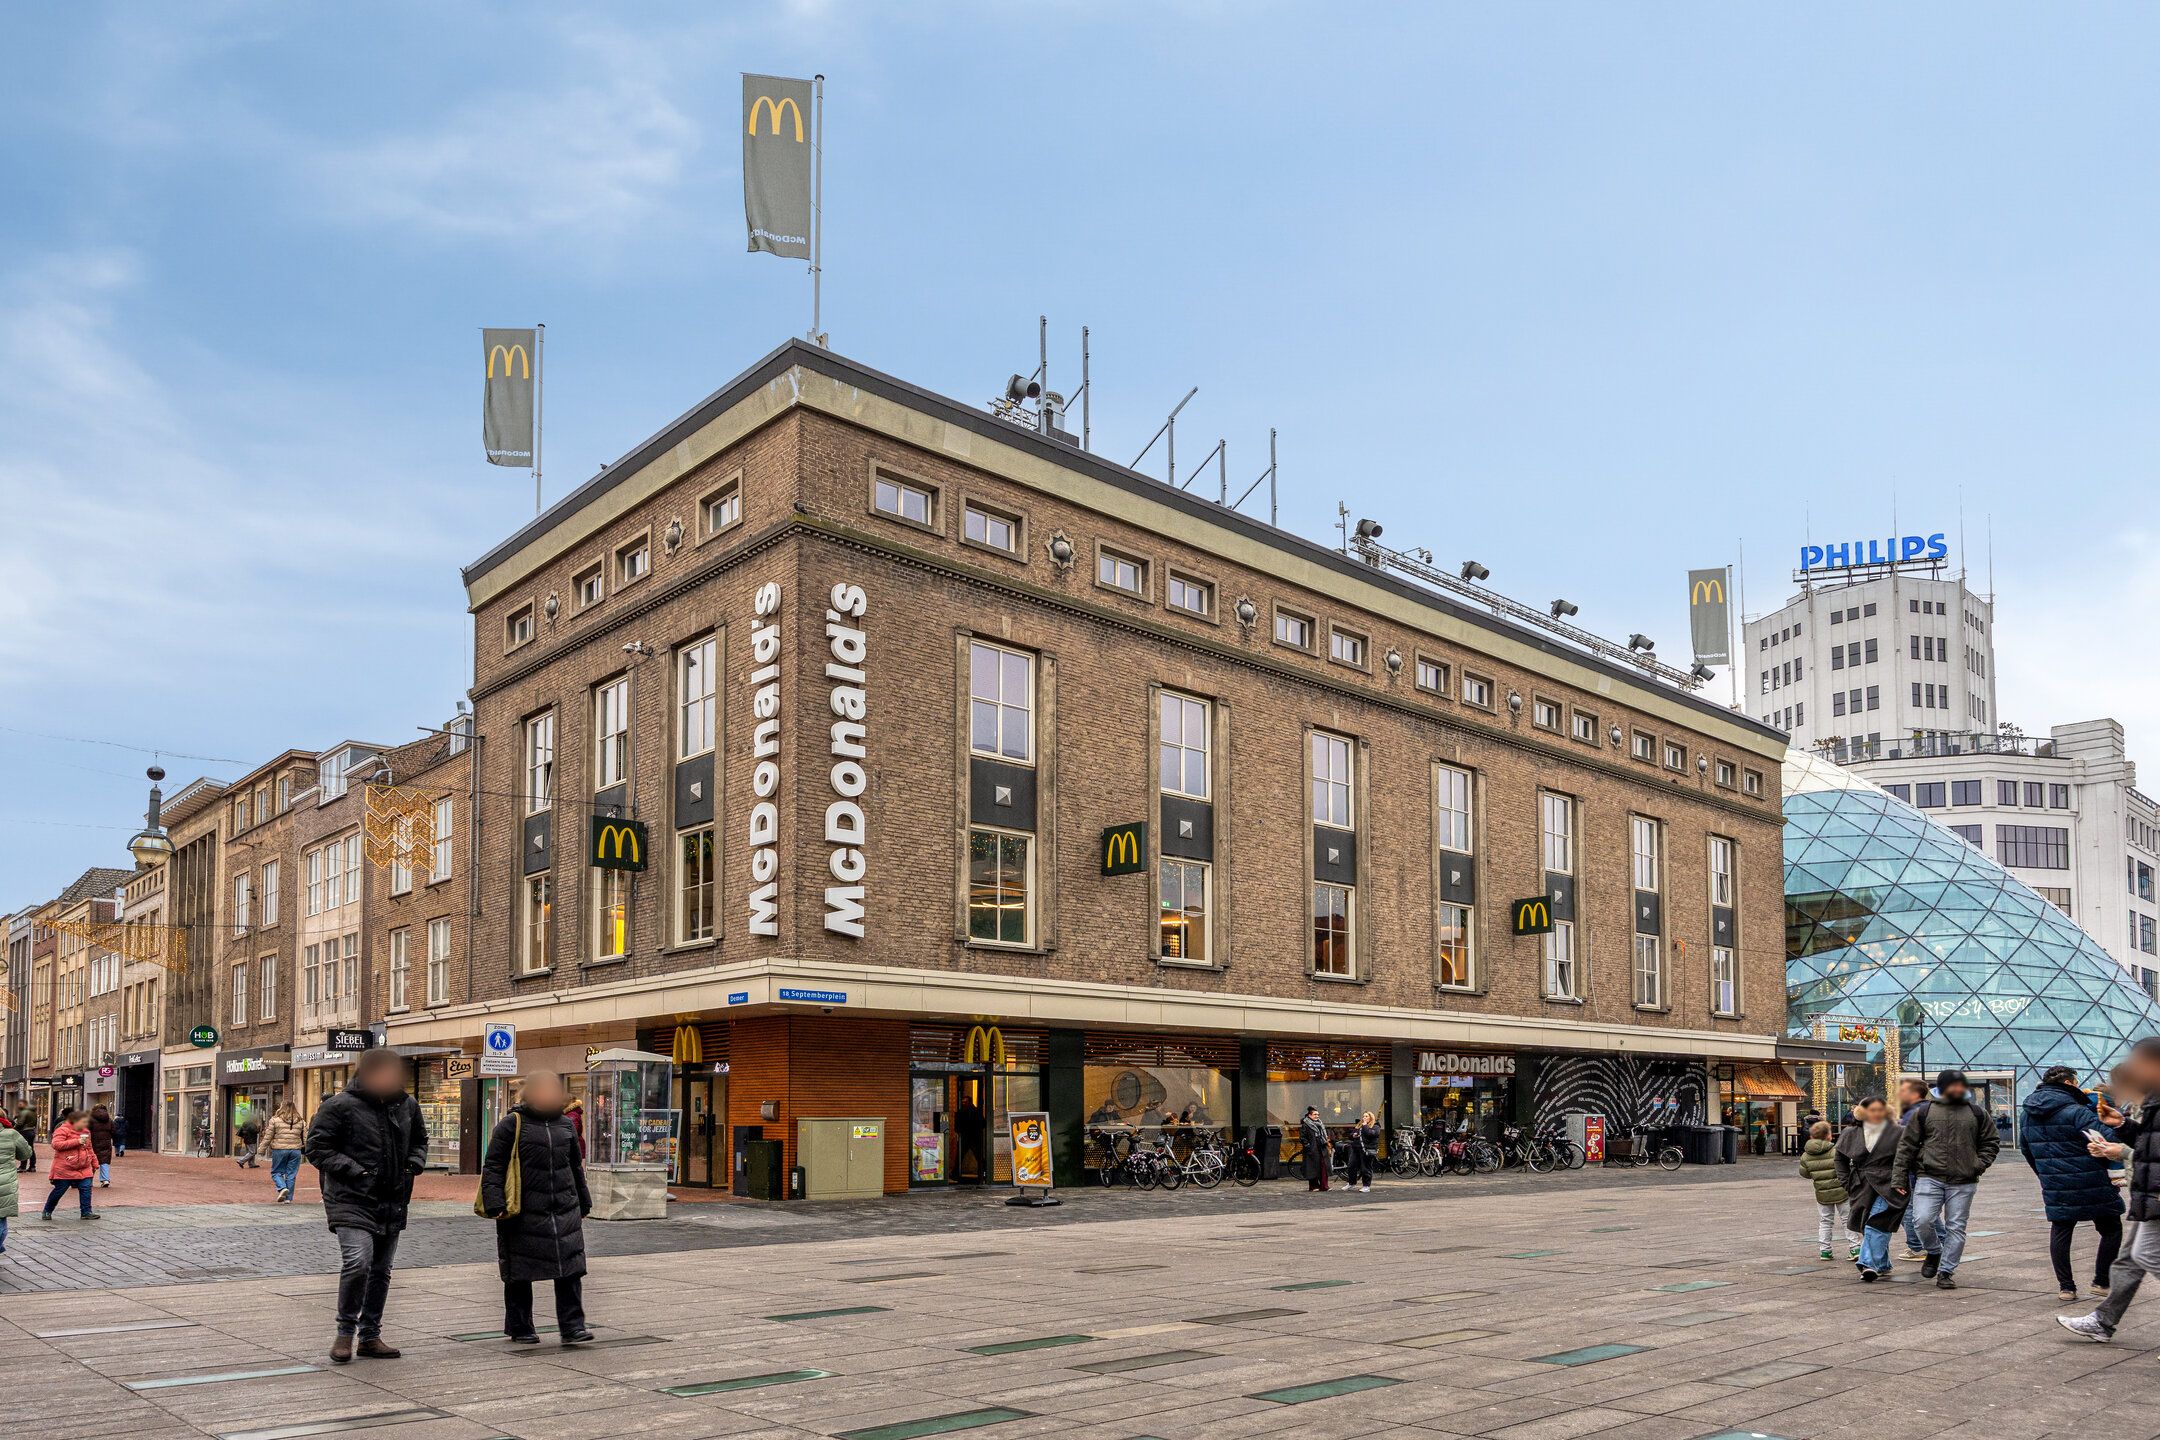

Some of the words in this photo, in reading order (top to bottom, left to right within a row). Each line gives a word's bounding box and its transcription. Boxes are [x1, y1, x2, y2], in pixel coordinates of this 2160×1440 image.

[1800, 533, 1948, 570] PHILIPS
[750, 581, 782, 936] McDonald's
[824, 582, 867, 938] McDonald's
[791, 991, 846, 1001] Septemberplein
[1919, 997, 2031, 1020] SISSY-BOY
[335, 1035, 365, 1045] SIEBEL
[449, 1060, 472, 1072] Etos
[1419, 1052, 1516, 1074] McDonald's
